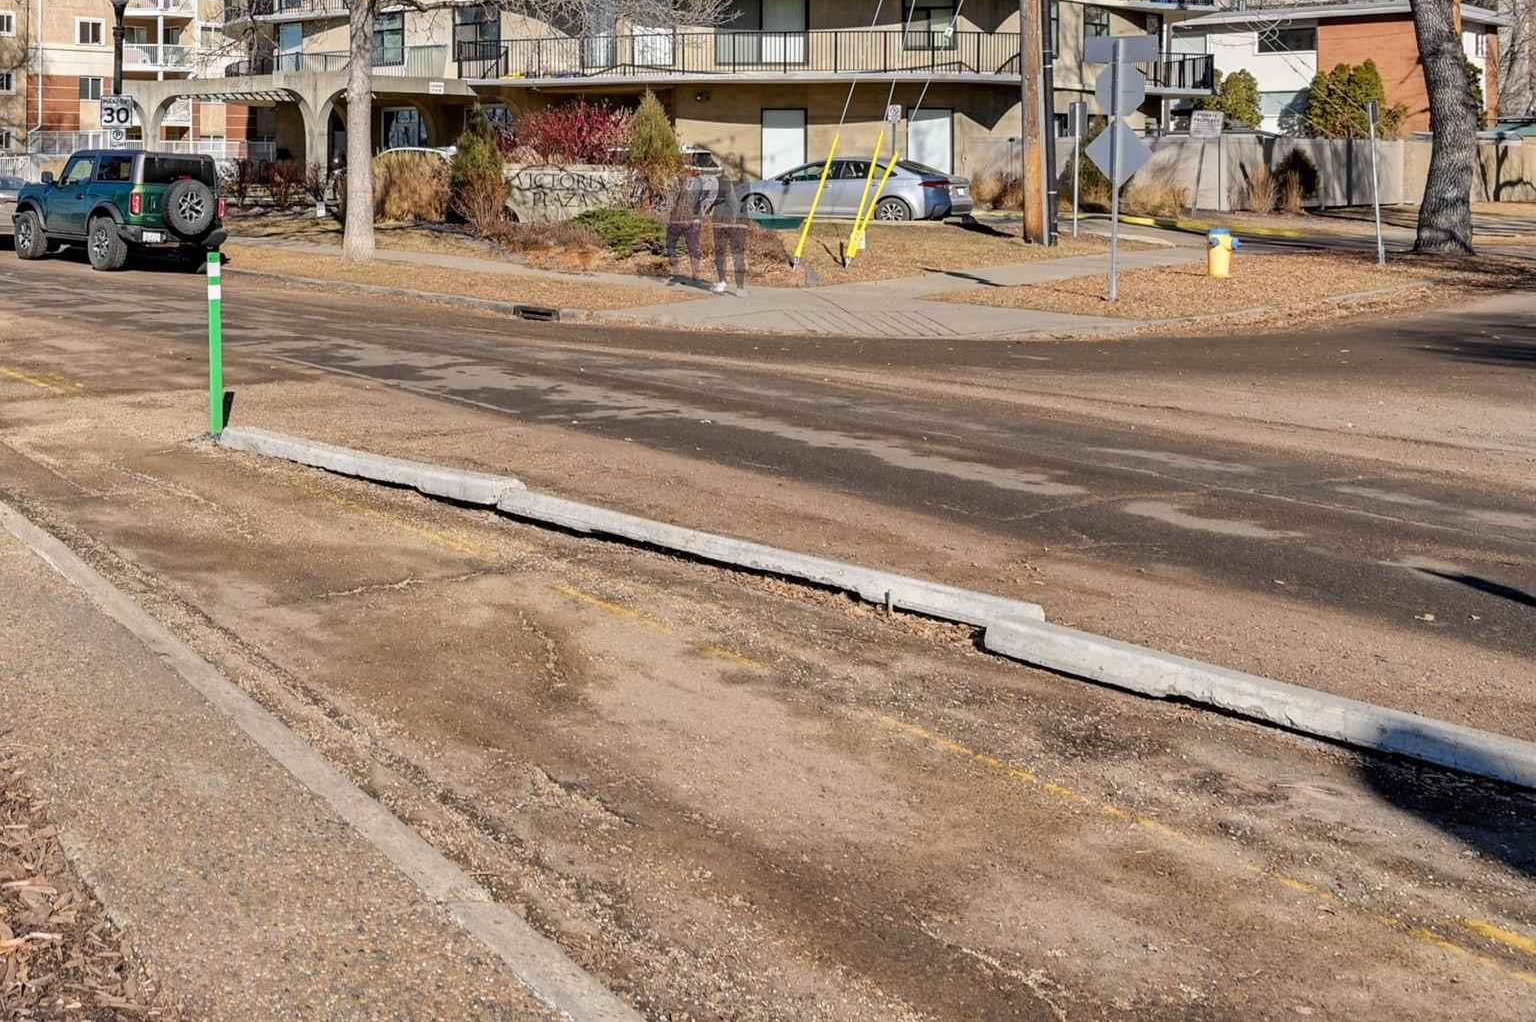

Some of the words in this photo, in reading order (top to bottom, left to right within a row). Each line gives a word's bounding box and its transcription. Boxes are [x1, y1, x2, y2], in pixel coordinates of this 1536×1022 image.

[103, 107, 130, 124] 30
[516, 172, 609, 190] VICTORIA
[533, 192, 589, 208] PLAZA
